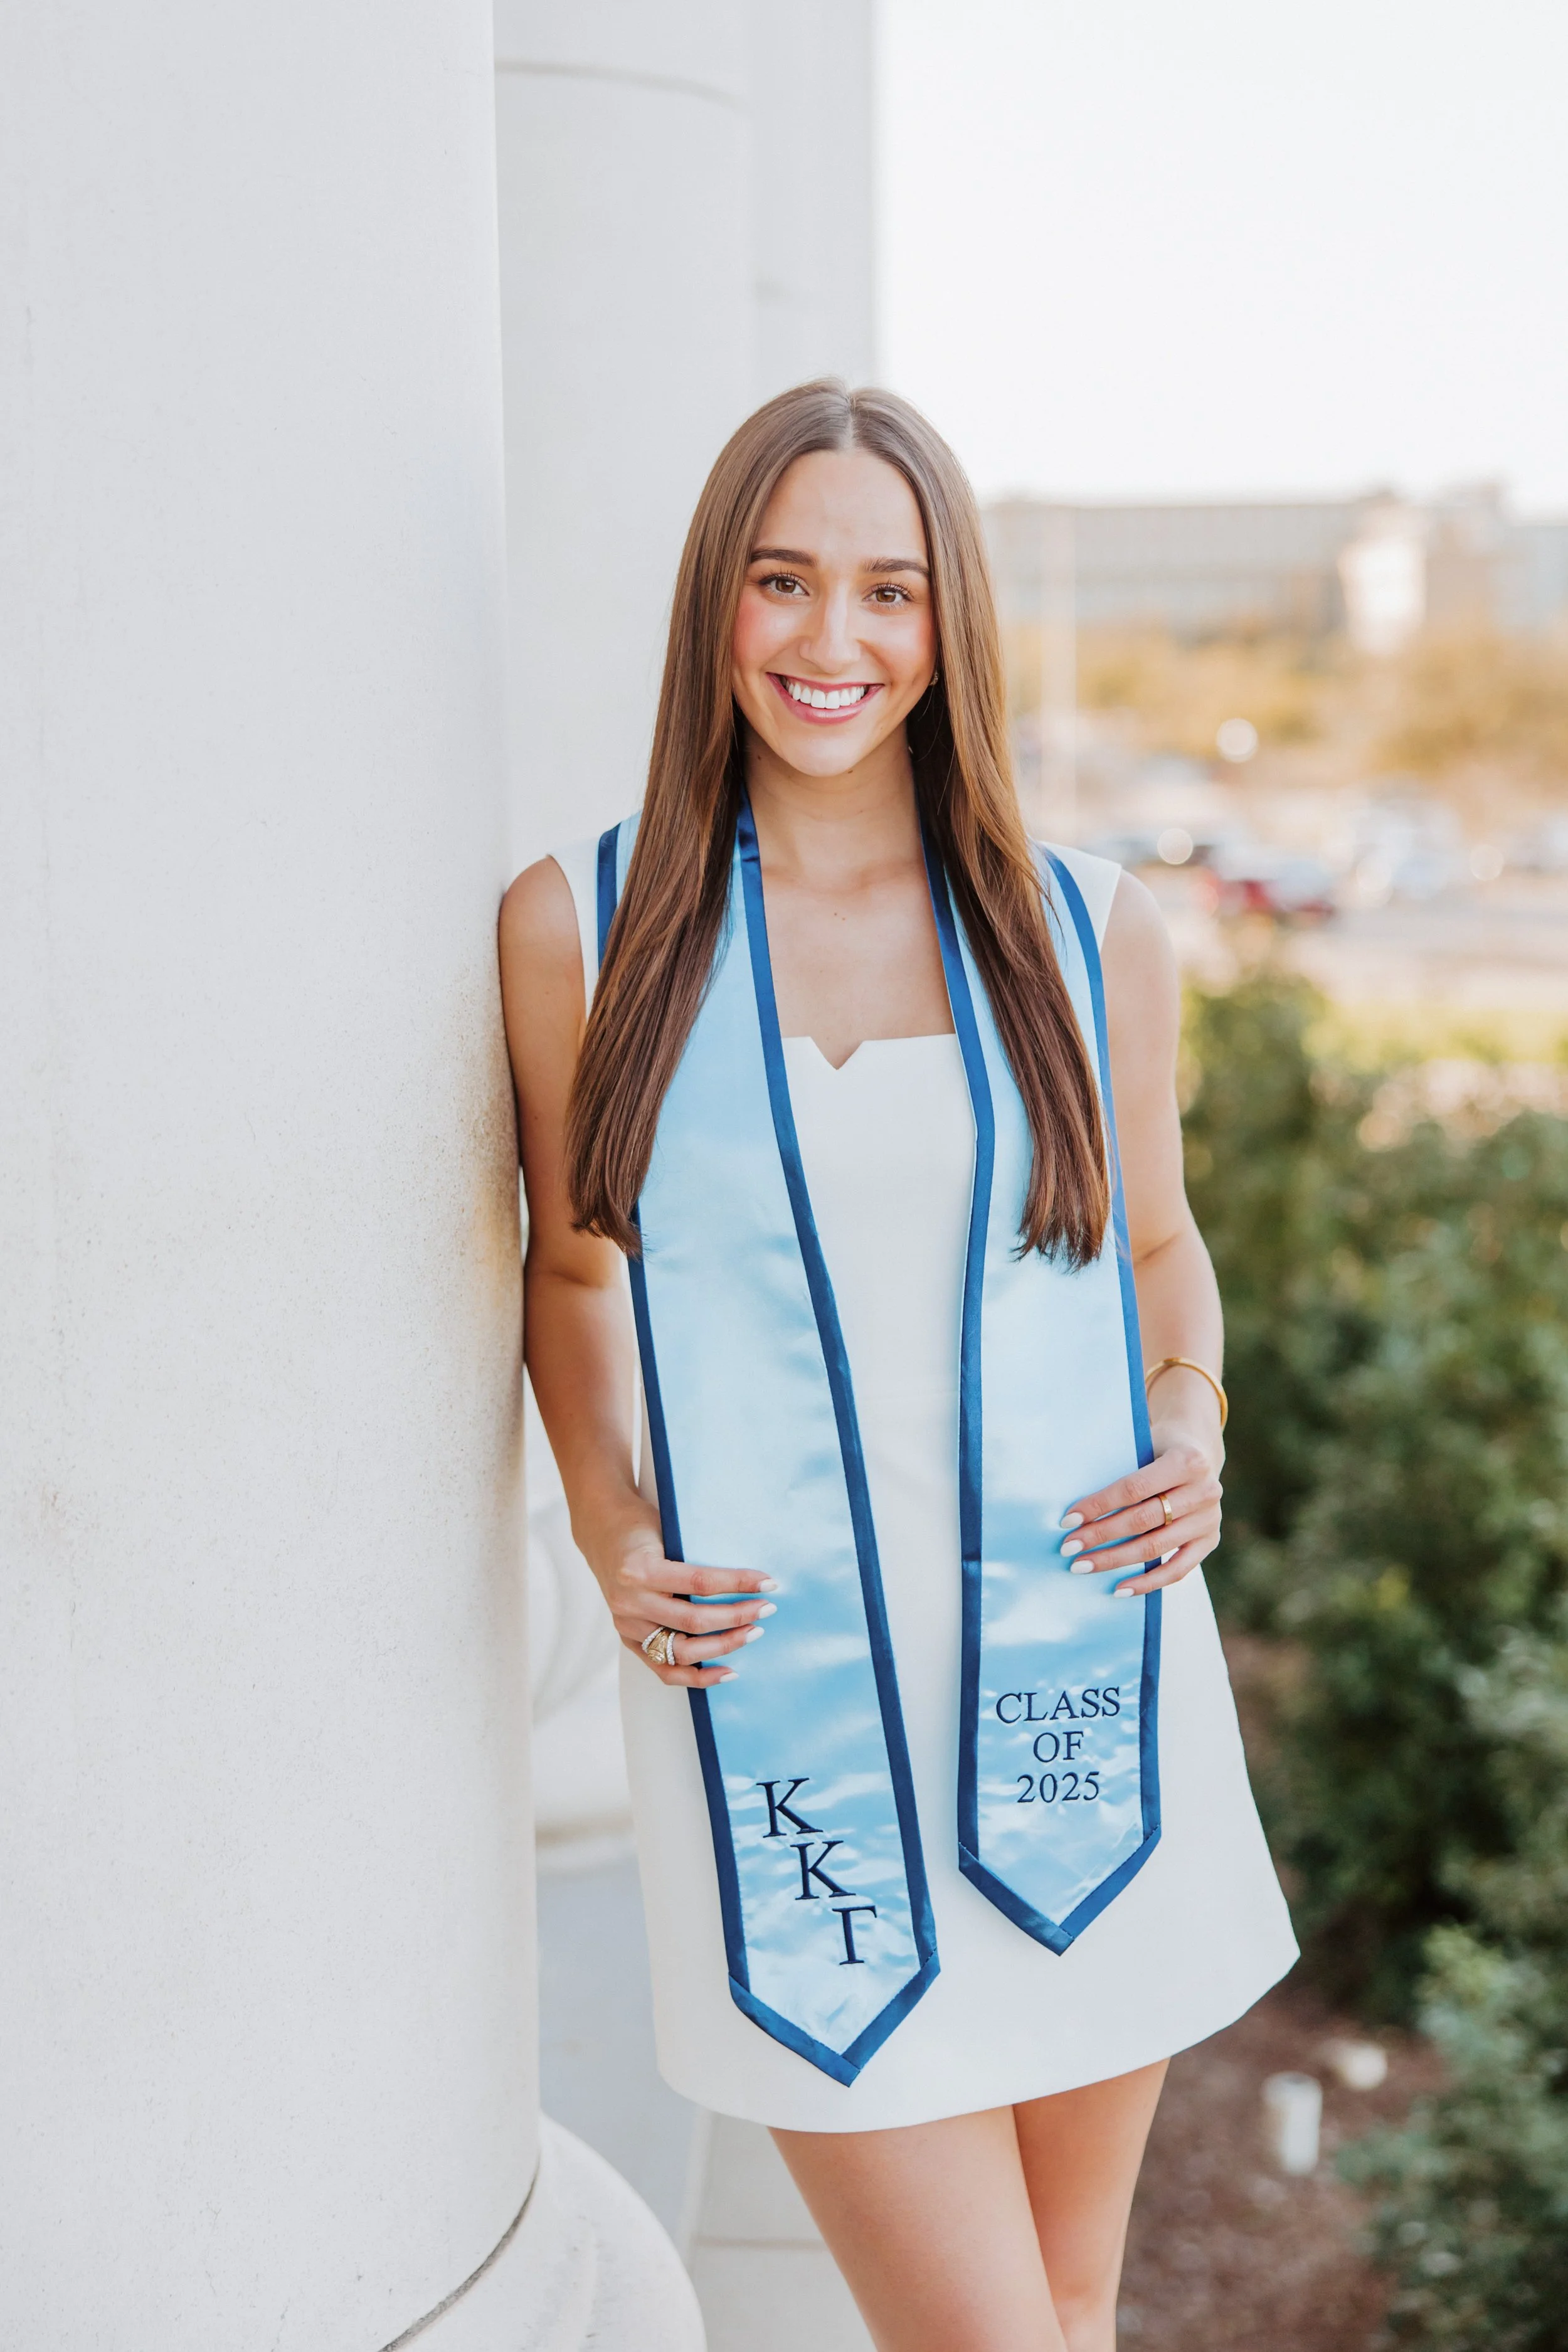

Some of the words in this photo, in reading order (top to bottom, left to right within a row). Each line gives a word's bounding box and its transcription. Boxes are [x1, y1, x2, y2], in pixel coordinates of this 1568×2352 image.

[996, 1687, 1120, 1724] CLASS
[1033, 1730, 1084, 1763] OF
[1017, 1771, 1100, 1803] 2025
